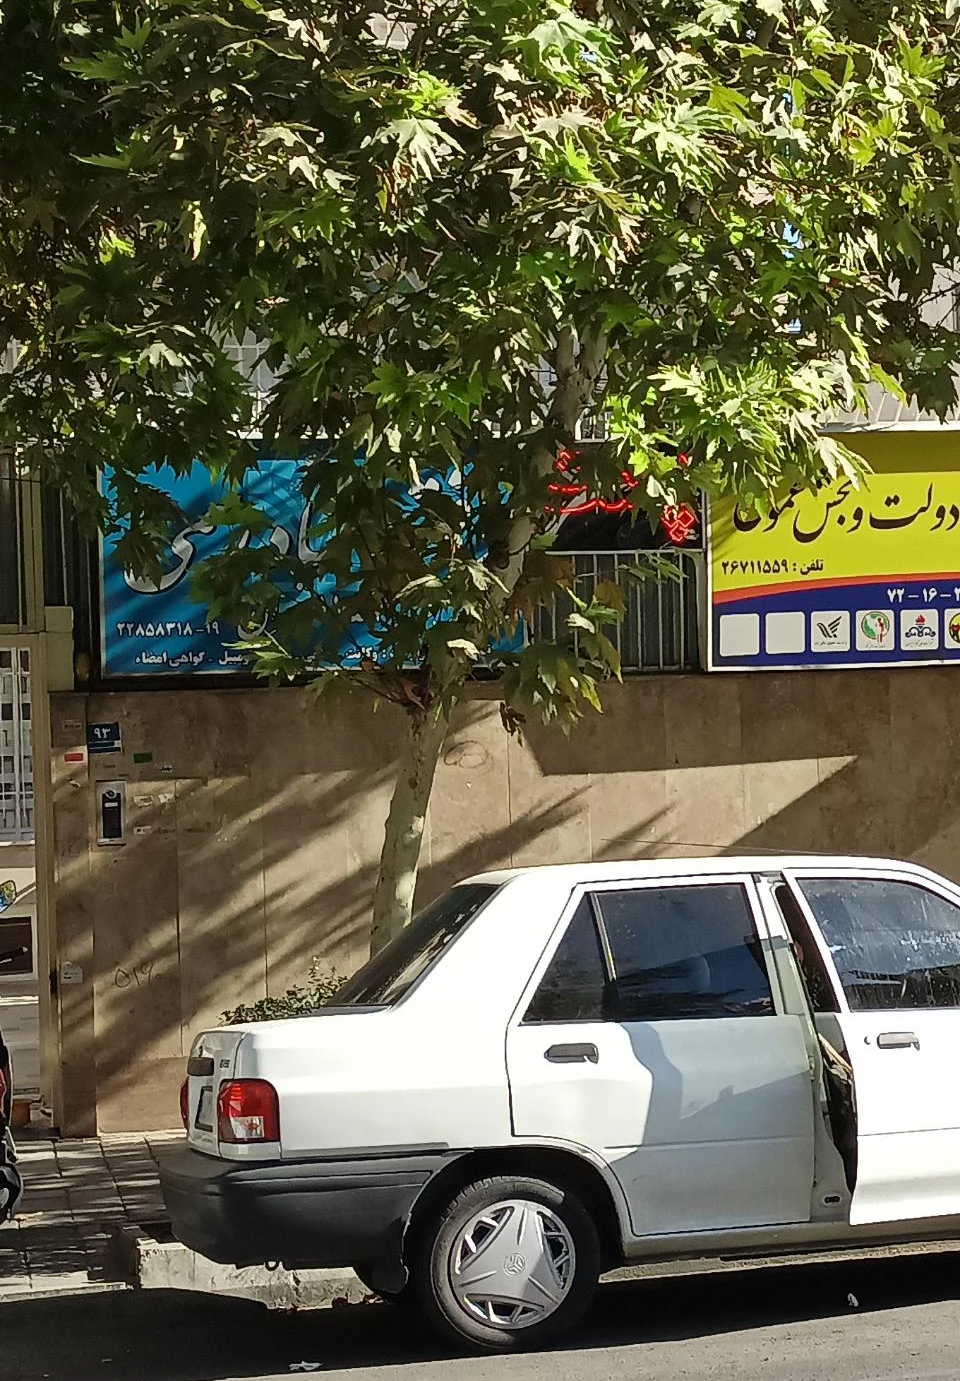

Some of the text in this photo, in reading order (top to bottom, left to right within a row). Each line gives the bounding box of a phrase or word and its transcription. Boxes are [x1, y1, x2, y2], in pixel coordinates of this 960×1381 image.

[869, 482, 960, 532] دولت
[847, 506, 864, 533] و
[721, 559, 789, 575] ۲۶۷۱۱۵۵۹
[800, 559, 824, 575] تلفن
[886, 588, 905, 603] ۷۲
[922, 587, 938, 603] ۱۶
[135, 651, 168, 664] امضاء
[93, 727, 112, 739] ۹۳
